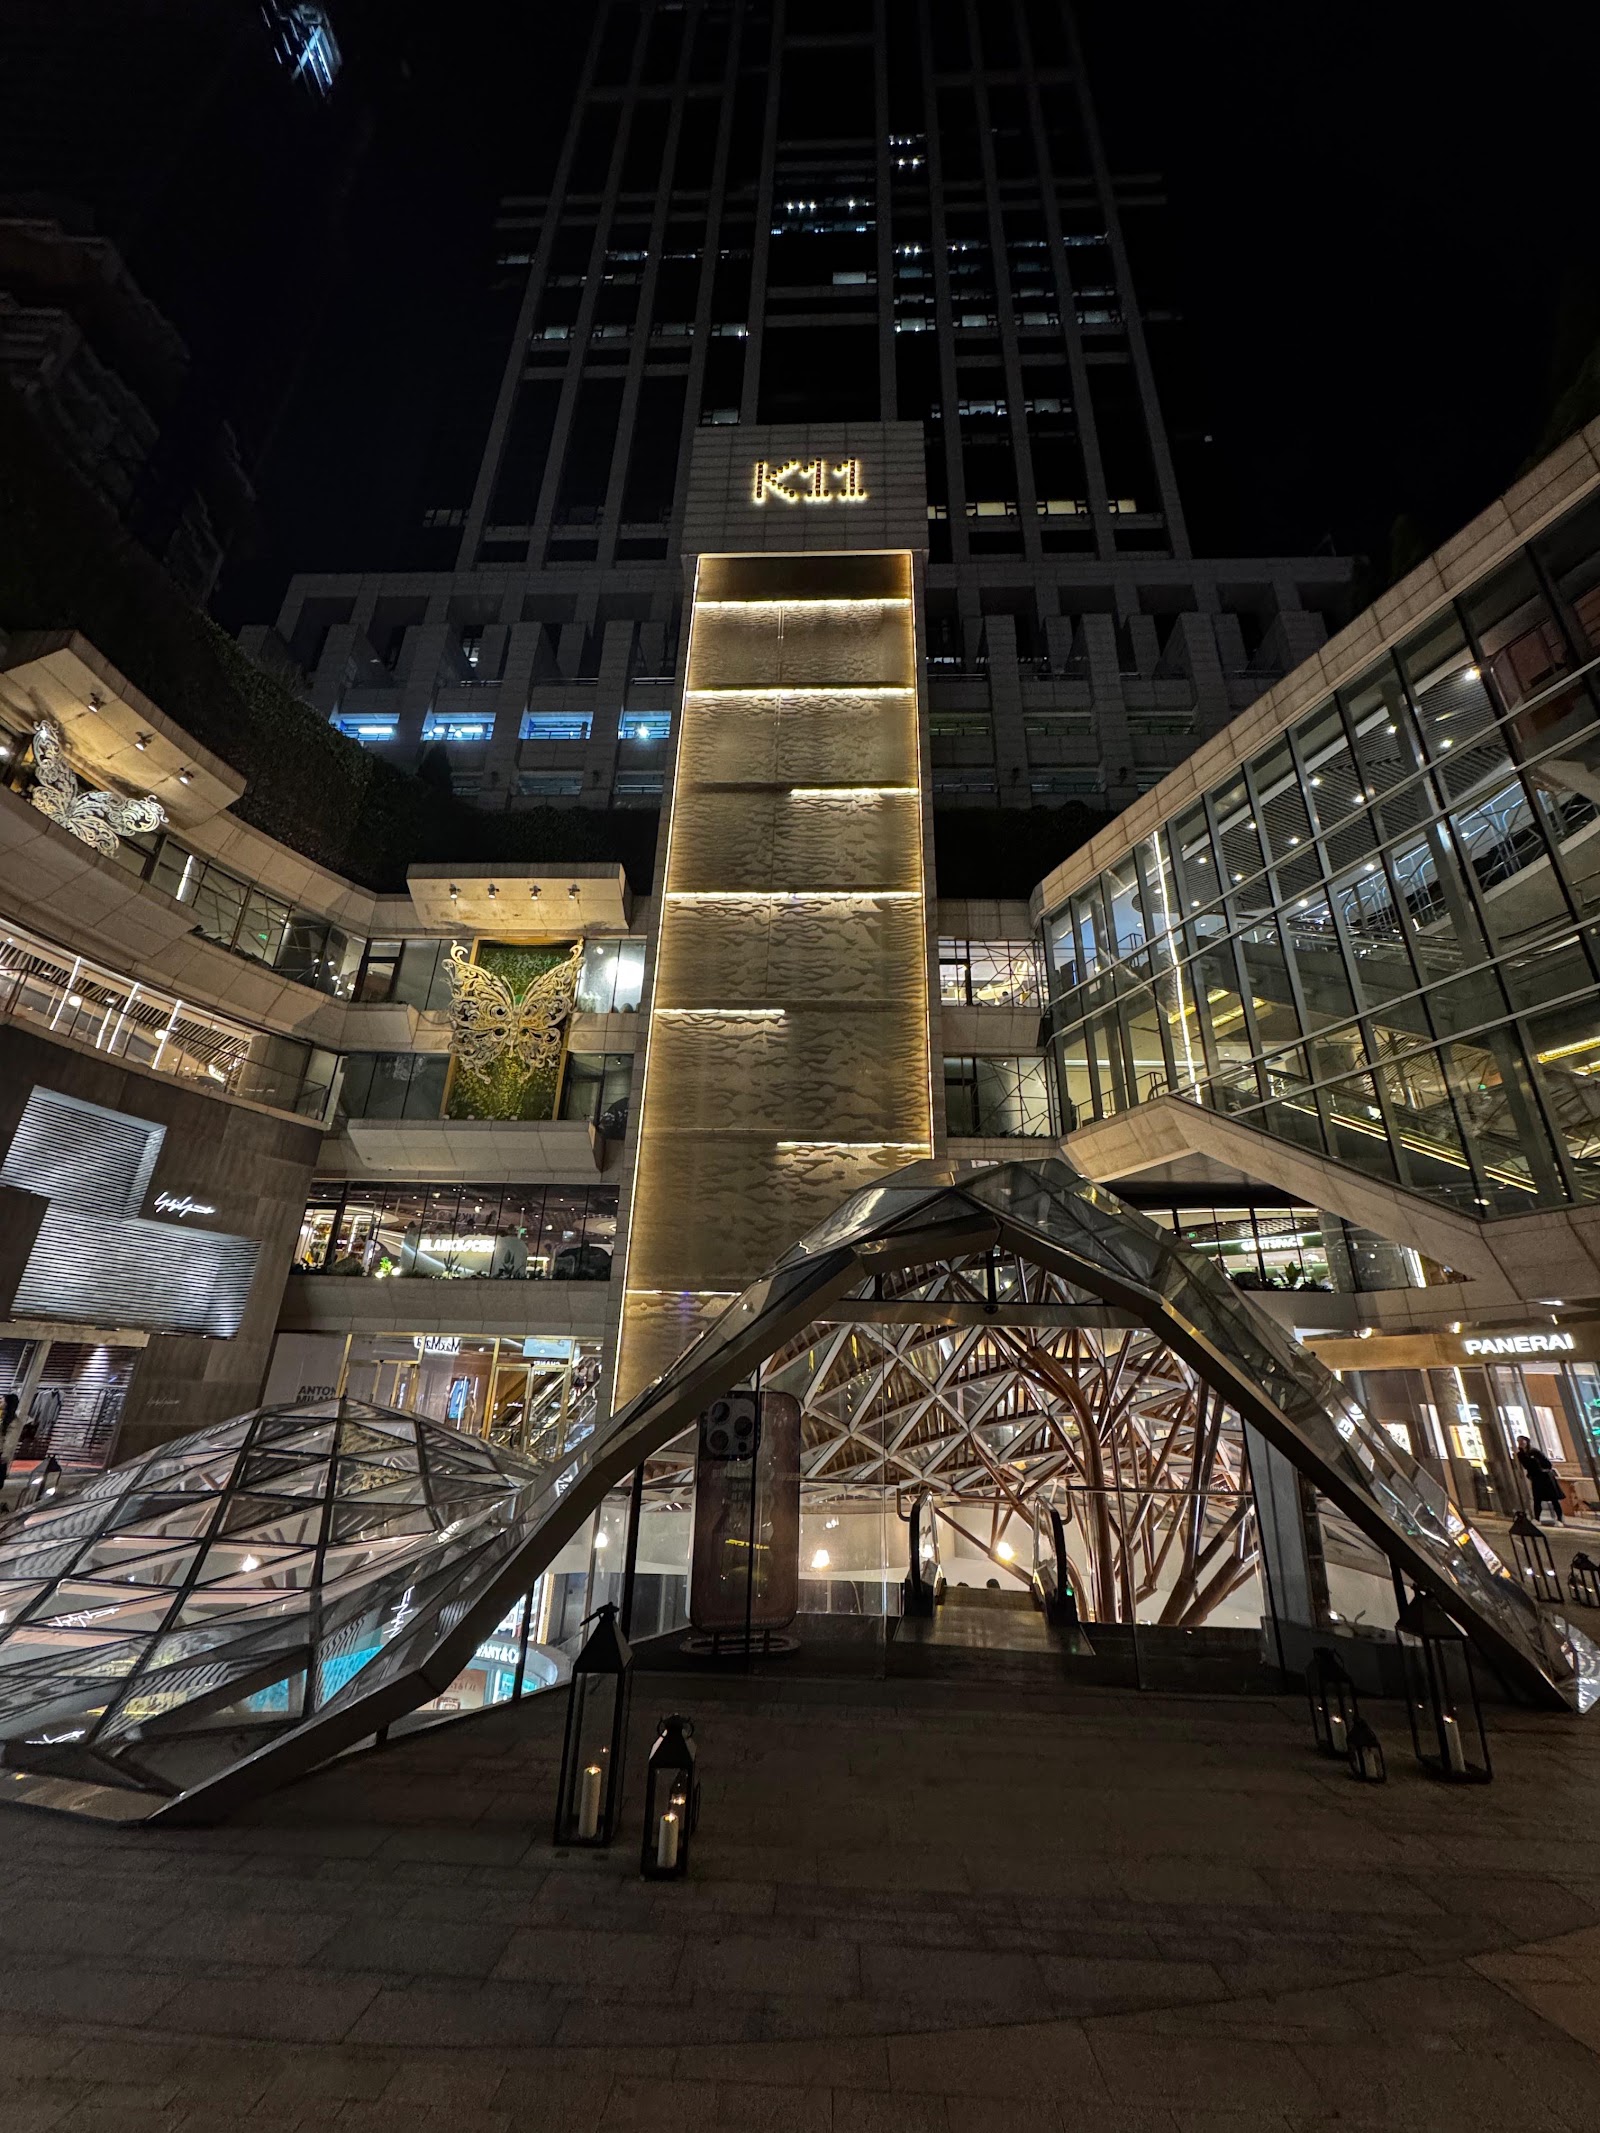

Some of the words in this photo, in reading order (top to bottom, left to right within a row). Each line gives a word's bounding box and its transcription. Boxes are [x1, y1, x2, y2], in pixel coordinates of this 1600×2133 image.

[754, 457, 868, 502] K11
[1464, 1333, 1575, 1356] PANERAI
[298, 1386, 348, 1396] ANTON
